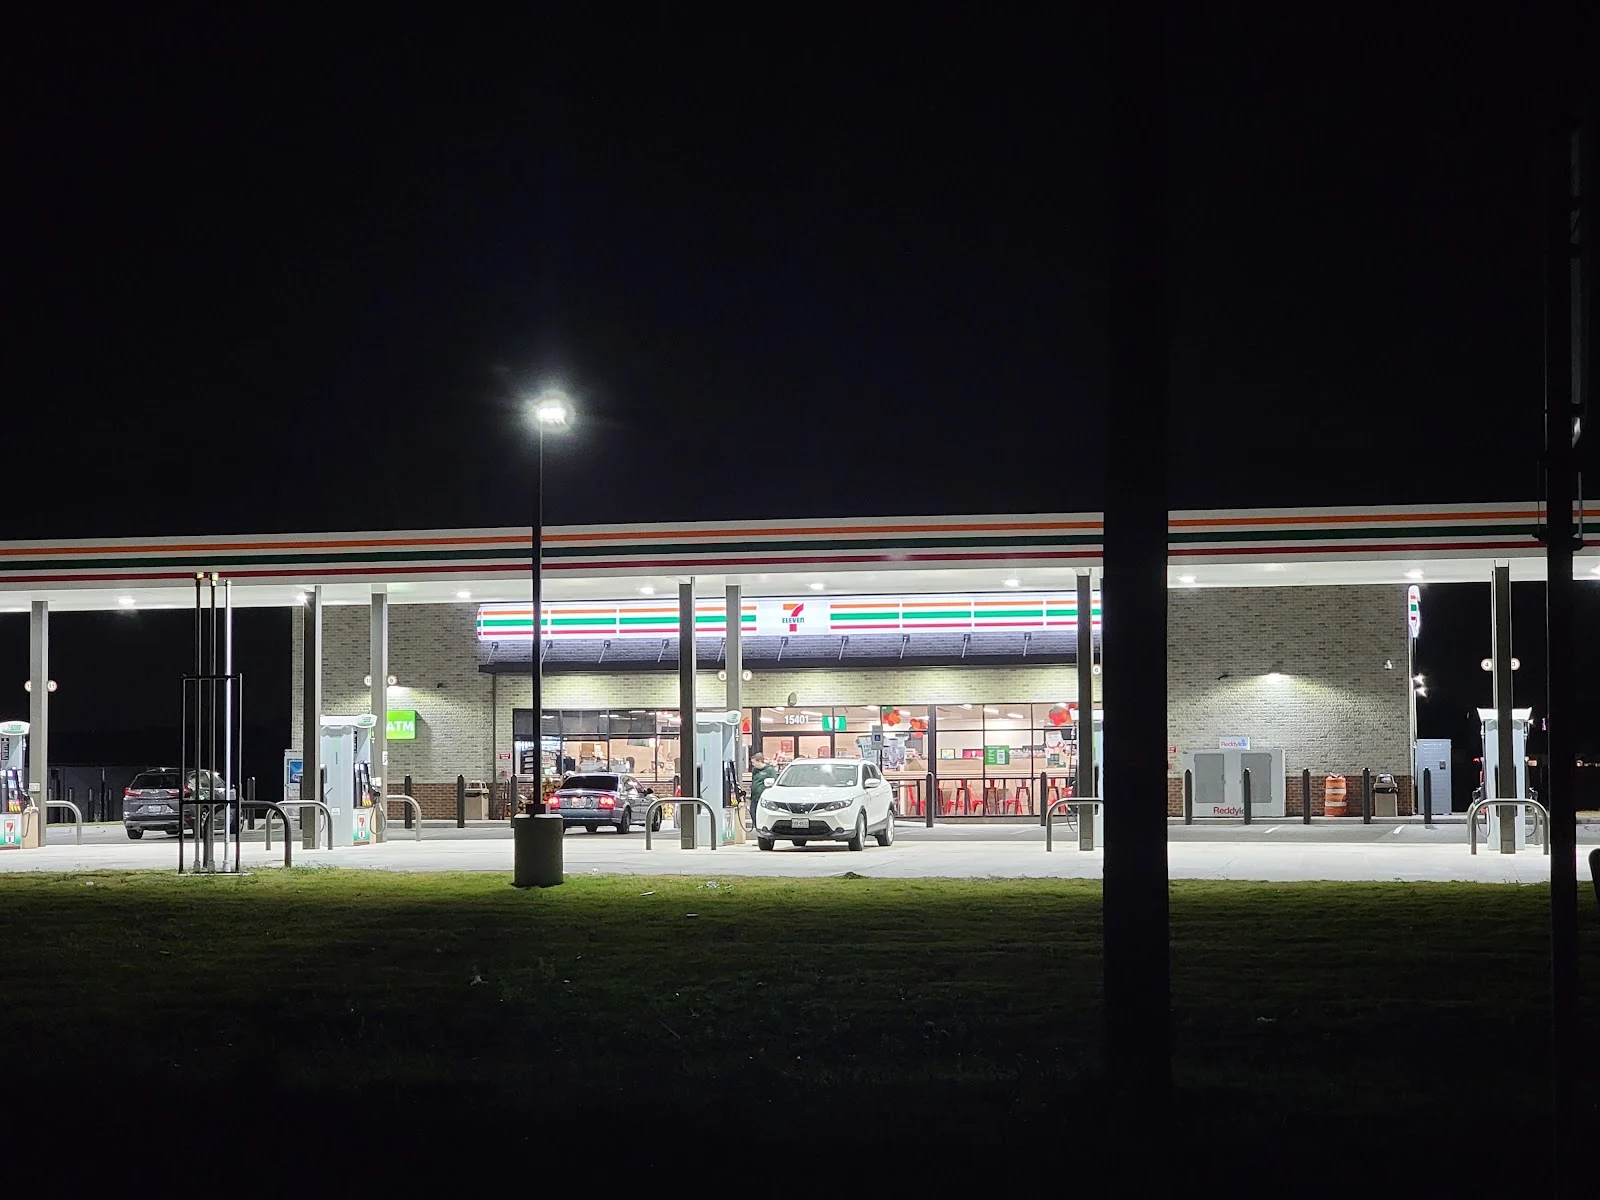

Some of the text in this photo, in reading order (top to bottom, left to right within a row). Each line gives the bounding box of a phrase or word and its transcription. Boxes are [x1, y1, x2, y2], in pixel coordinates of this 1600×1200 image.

[783, 603, 804, 632] 7
[784, 715, 809, 724] 15401
[386, 720, 414, 732] ATM
[1213, 806, 1245, 815] ReddyIc
